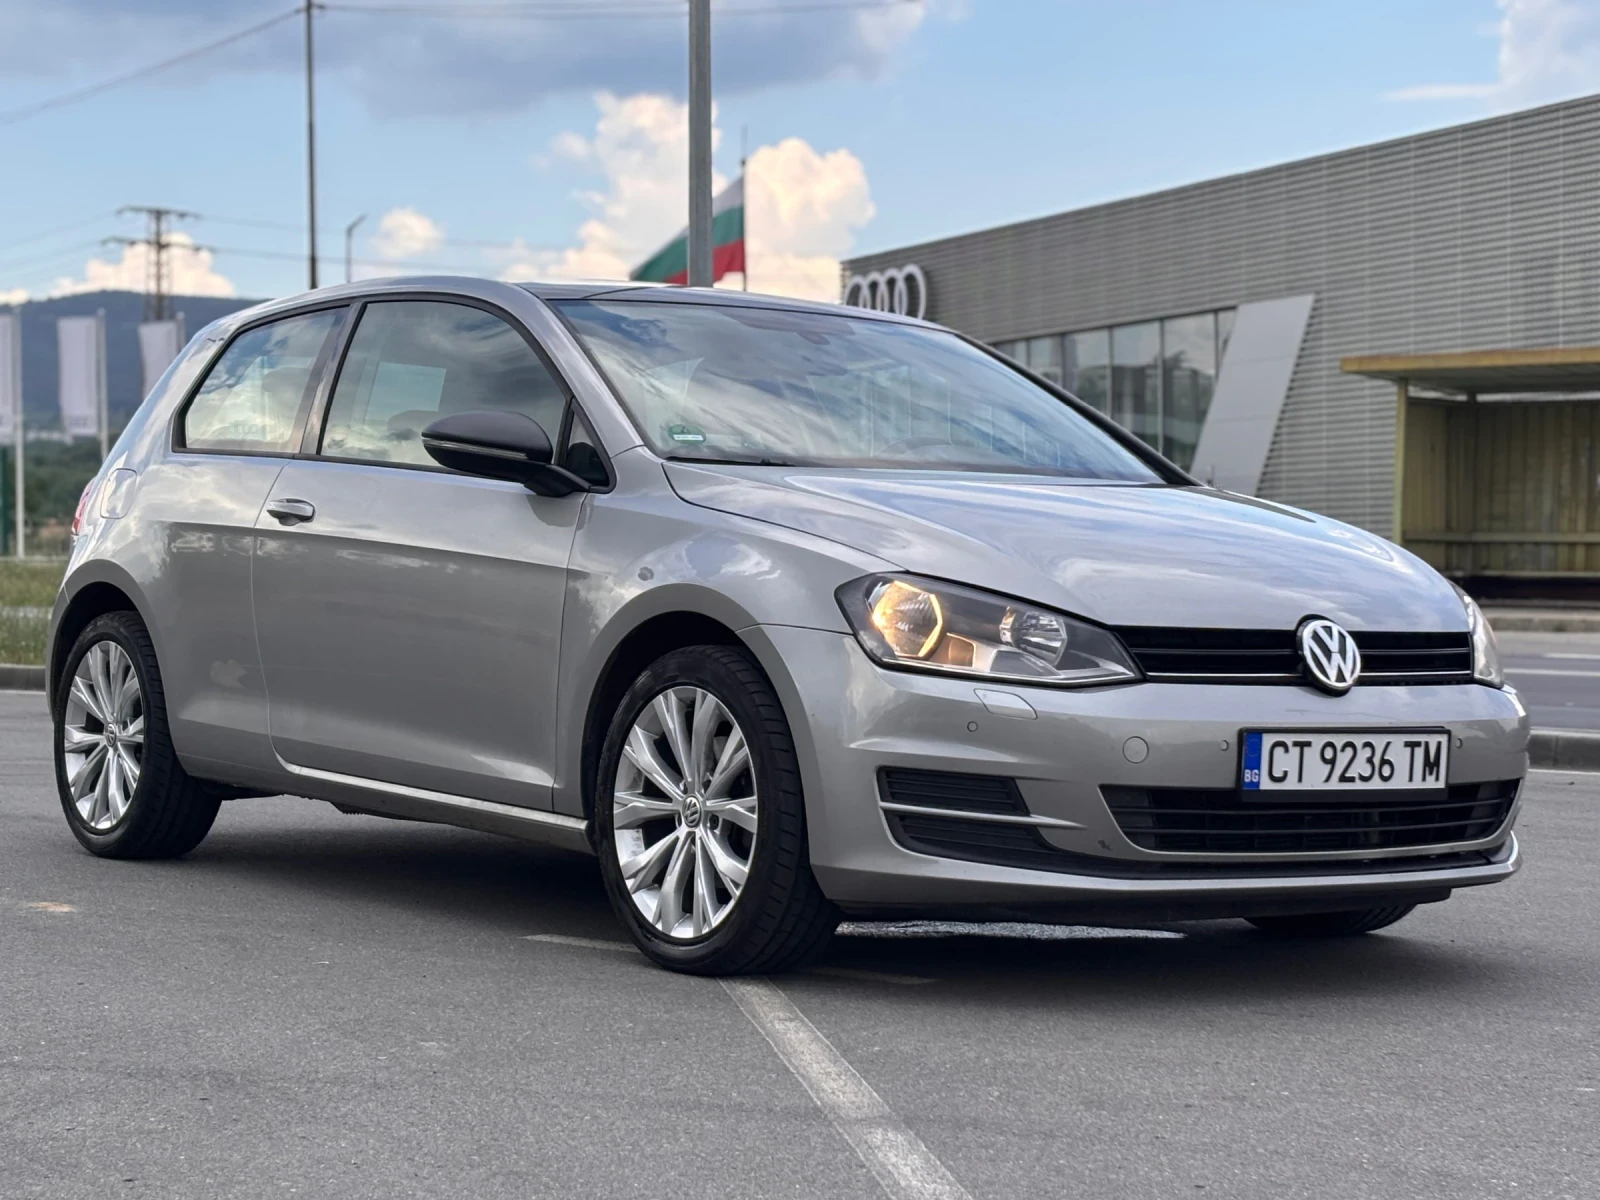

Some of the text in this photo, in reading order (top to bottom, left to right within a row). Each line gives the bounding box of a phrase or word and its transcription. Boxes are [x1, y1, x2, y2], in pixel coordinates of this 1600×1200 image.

[1303, 620, 1361, 688] VW
[1244, 769, 1259, 782] BG
[1268, 740, 1442, 783] CT 9236 TM
